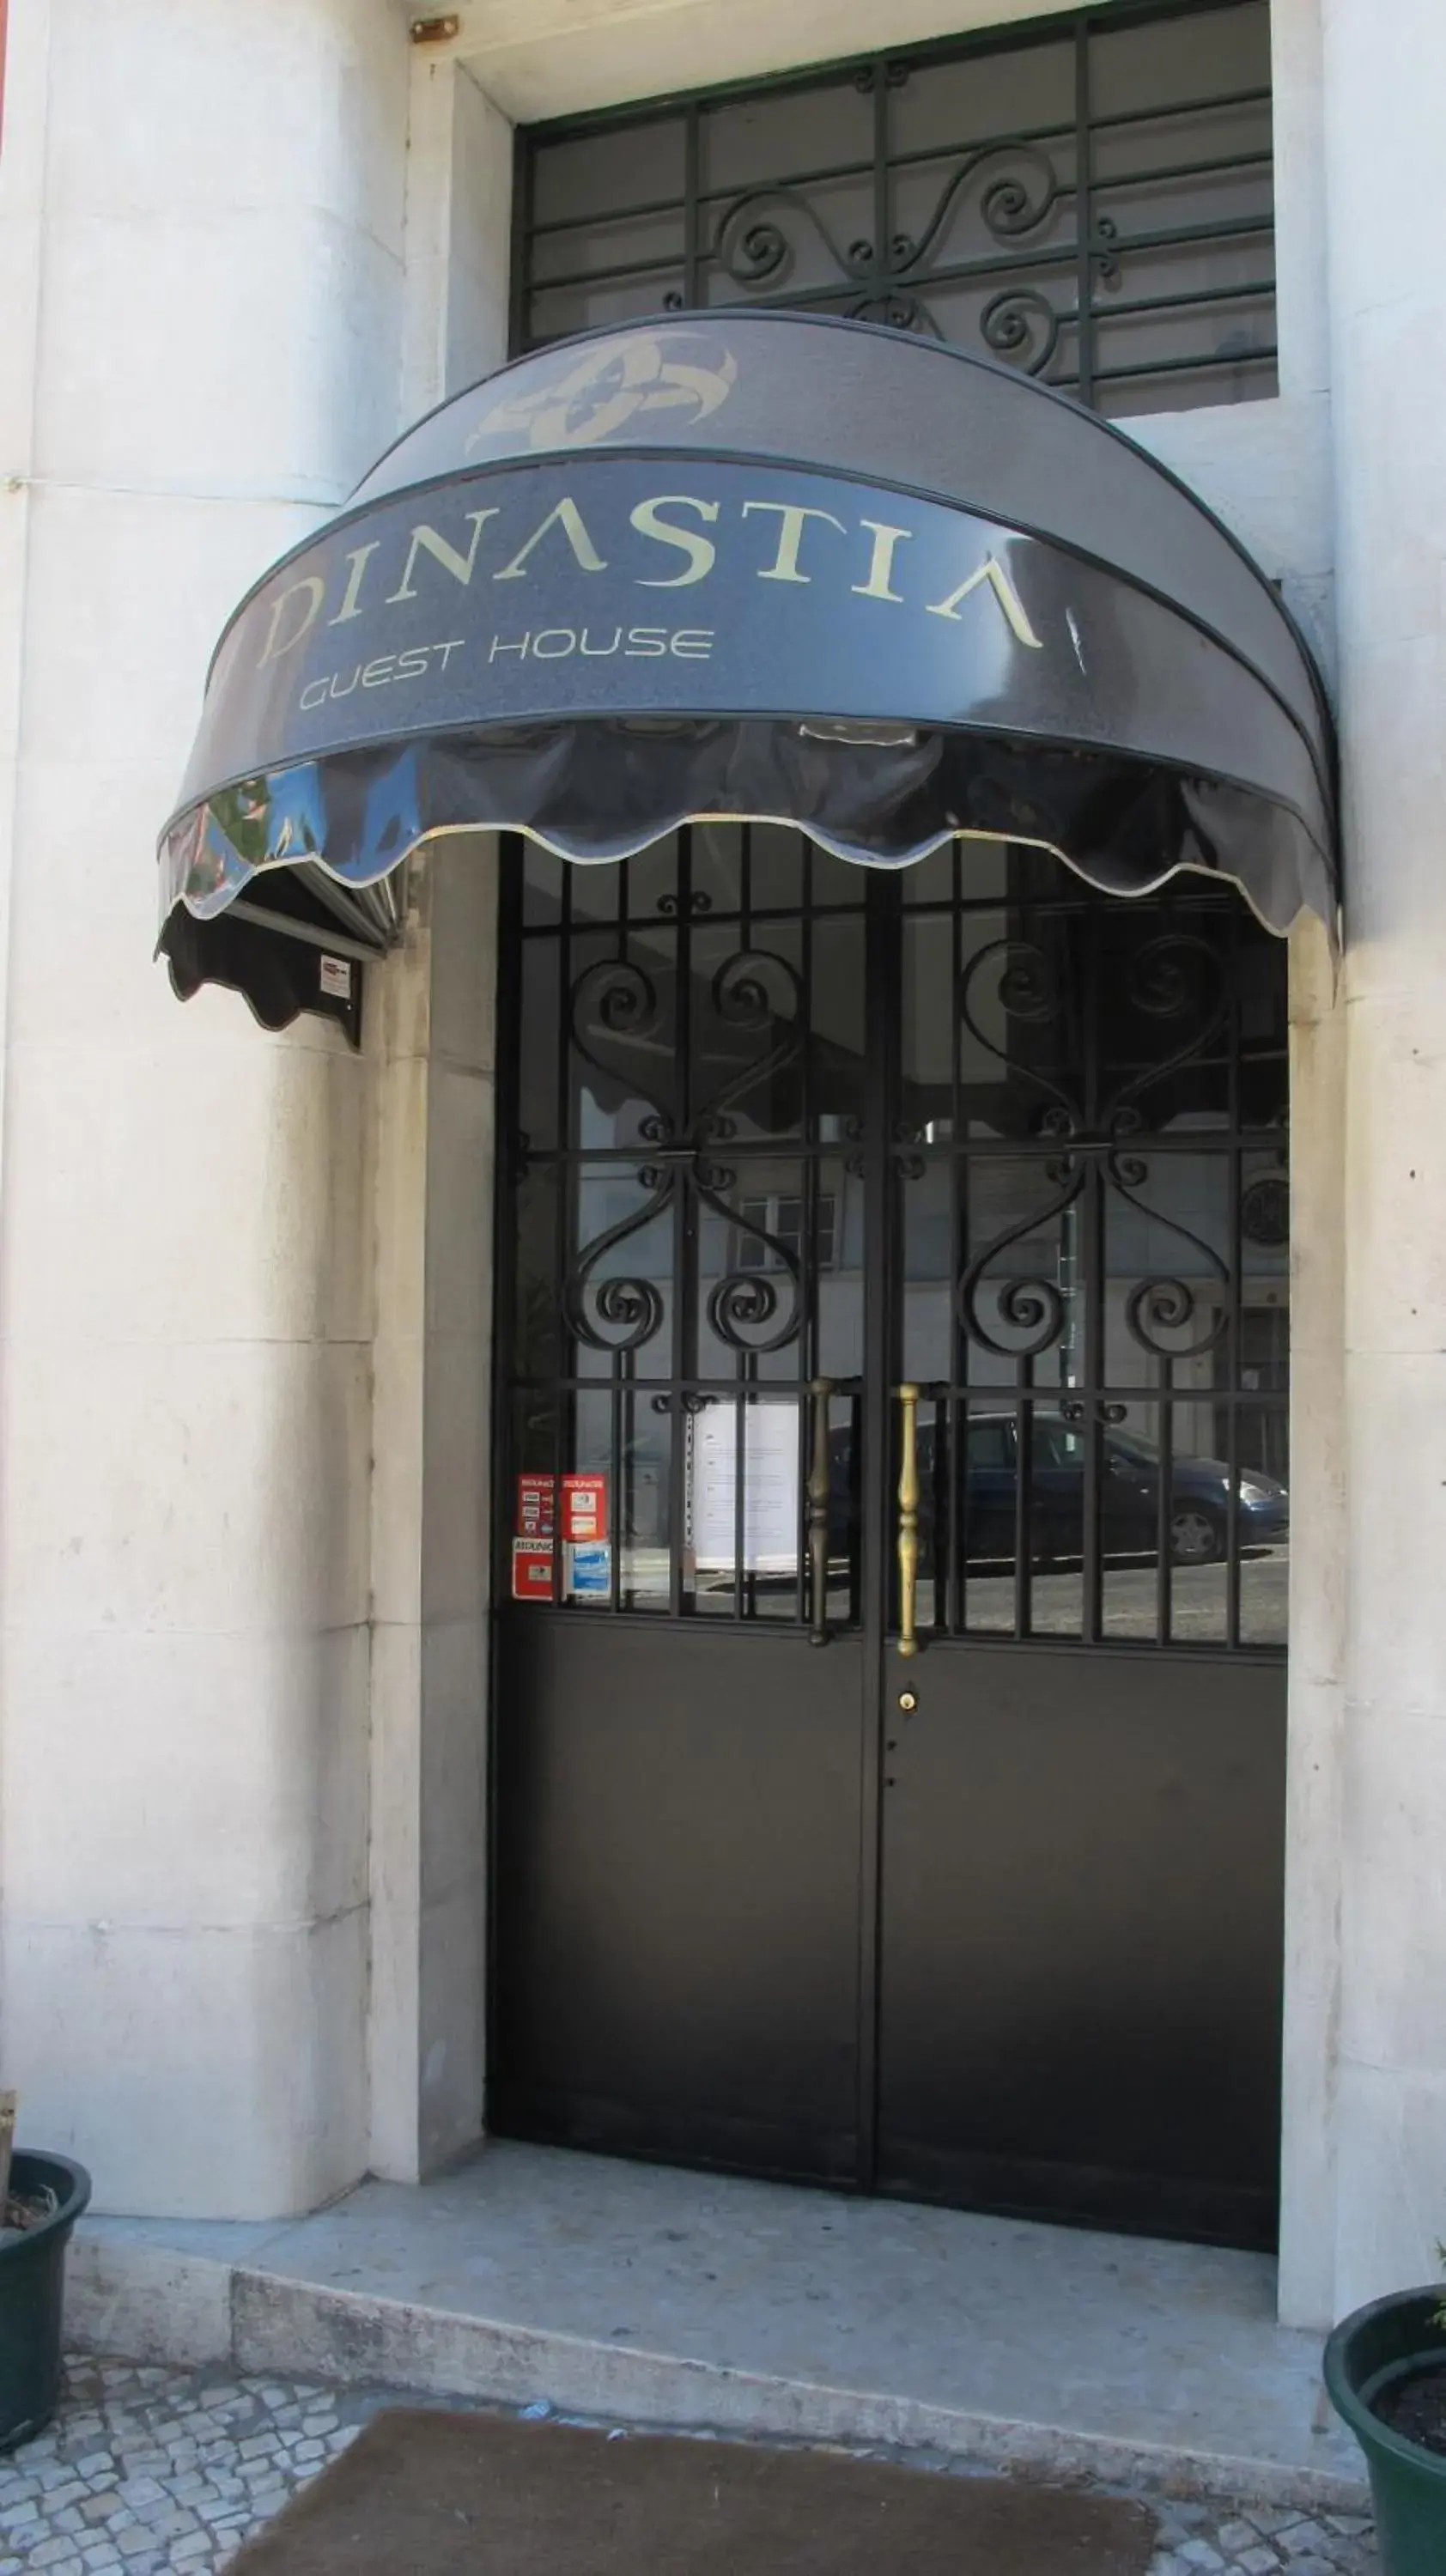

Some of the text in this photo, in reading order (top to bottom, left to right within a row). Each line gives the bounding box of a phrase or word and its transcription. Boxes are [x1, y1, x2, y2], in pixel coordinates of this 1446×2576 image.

[257, 495, 1043, 669] DINASTIA
[300, 627, 714, 710] GUEST HOUSE
